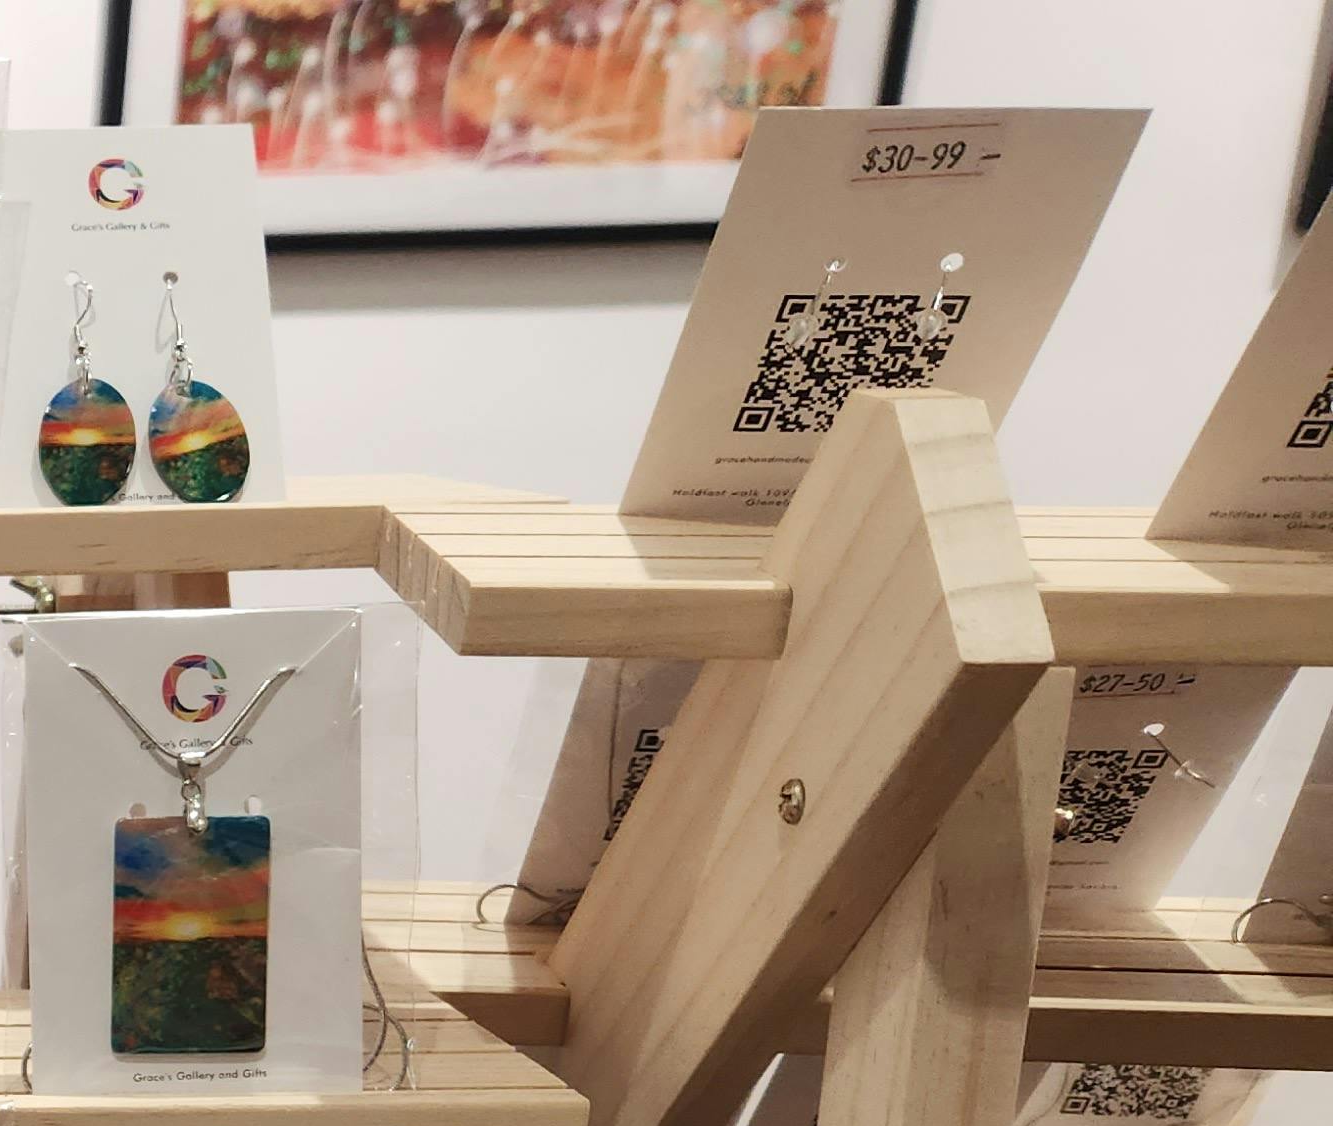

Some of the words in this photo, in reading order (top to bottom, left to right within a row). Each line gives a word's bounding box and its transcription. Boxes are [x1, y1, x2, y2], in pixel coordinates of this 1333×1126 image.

[862, 141, 966, 173] $30-99
[71, 223, 104, 232] Grace's
[106, 222, 137, 232] Gallery
[150, 222, 170, 230] Gifts
[1079, 673, 1165, 693] $27-50
[133, 1073, 172, 1083] Grace's
[176, 1071, 214, 1082] Gallery
[218, 1070, 238, 1079] and
[243, 1068, 267, 1078] Gifts
